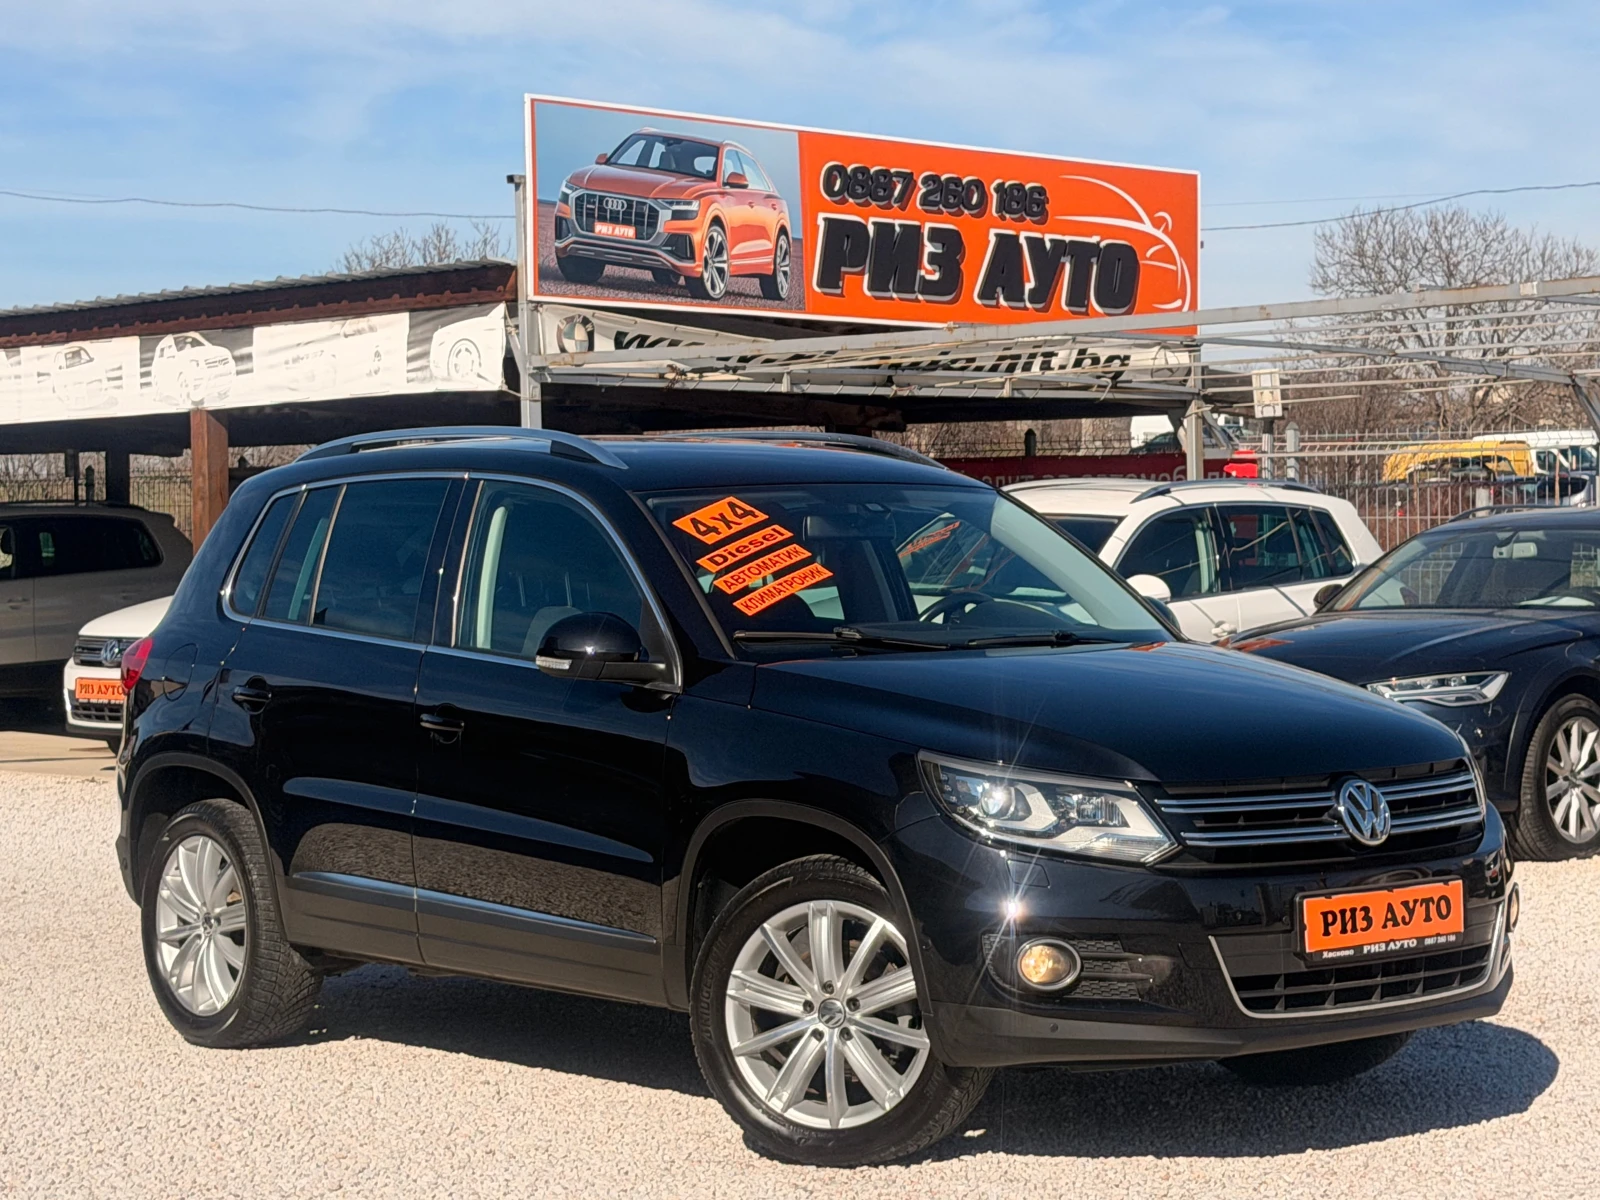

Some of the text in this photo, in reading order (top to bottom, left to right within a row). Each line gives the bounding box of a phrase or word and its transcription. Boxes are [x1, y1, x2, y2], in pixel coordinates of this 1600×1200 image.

[821, 162, 1048, 224] 0887 260 186
[813, 213, 1140, 315] РИЗ АУТО
[709, 528, 785, 567] Diesel
[723, 546, 806, 590] АВТОМАТИК
[741, 566, 828, 612] КЛИМАТРОНИК
[1320, 895, 1452, 937] РИЗ АУТО
[1363, 942, 1386, 954] РИЗ
[1387, 939, 1417, 952] АУТО
